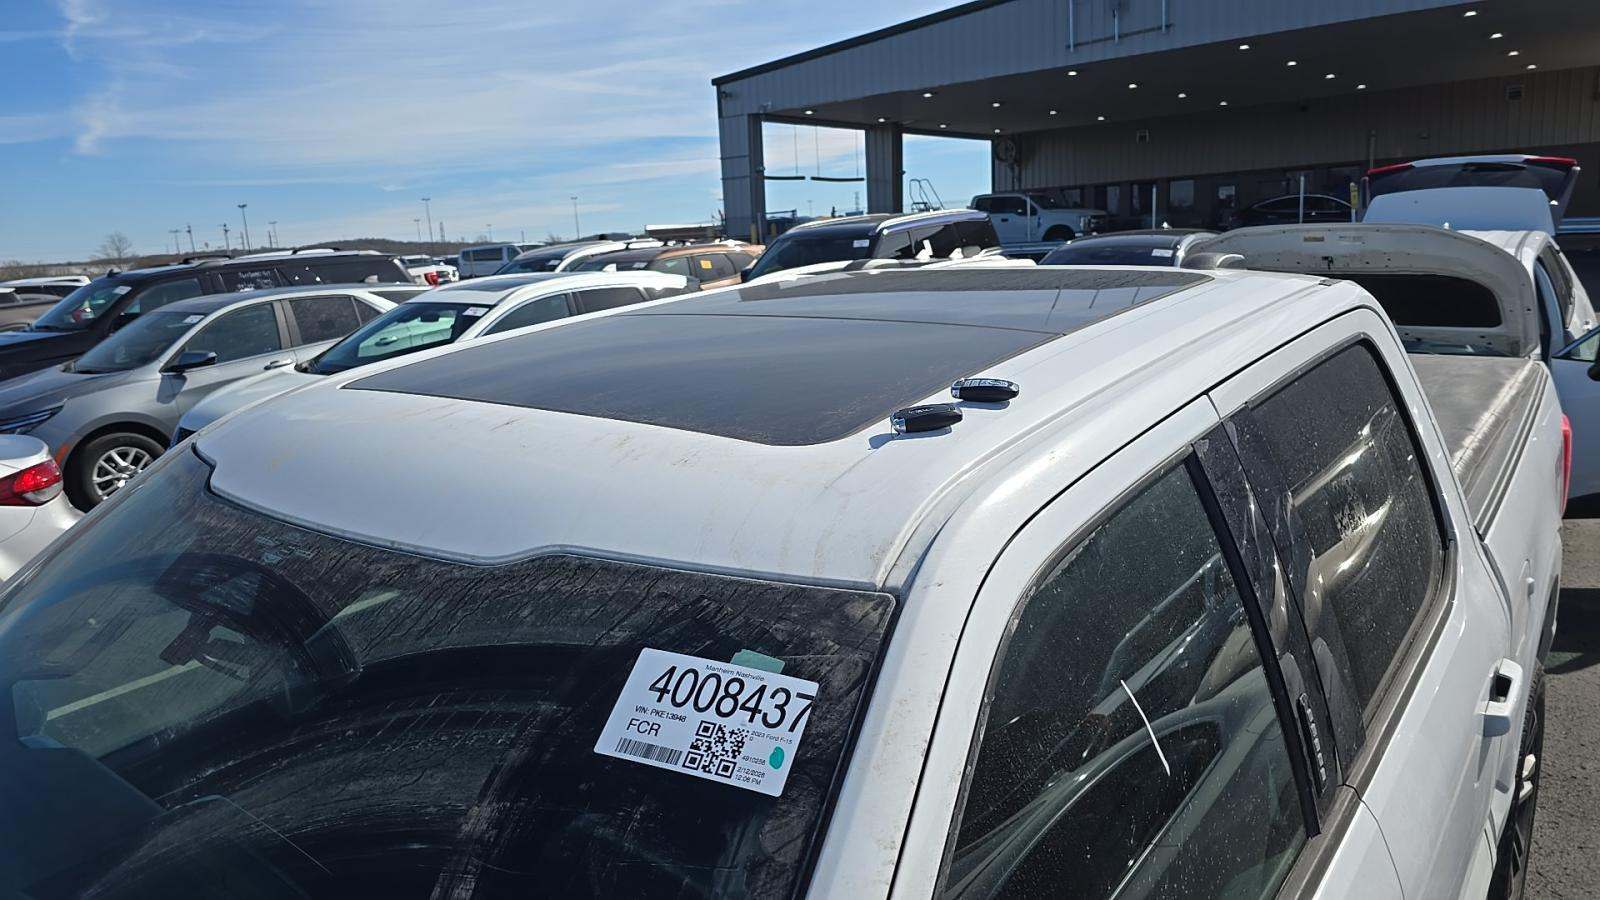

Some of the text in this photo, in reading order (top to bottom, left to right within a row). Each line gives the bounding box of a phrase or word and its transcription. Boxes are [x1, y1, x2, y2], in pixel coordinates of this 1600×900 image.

[705, 664, 765, 681] Manheim Nashville
[649, 665, 815, 732] 4008437
[635, 705, 649, 715] VIN:
[626, 717, 661, 737] FCR
[751, 777, 762, 785] PM
